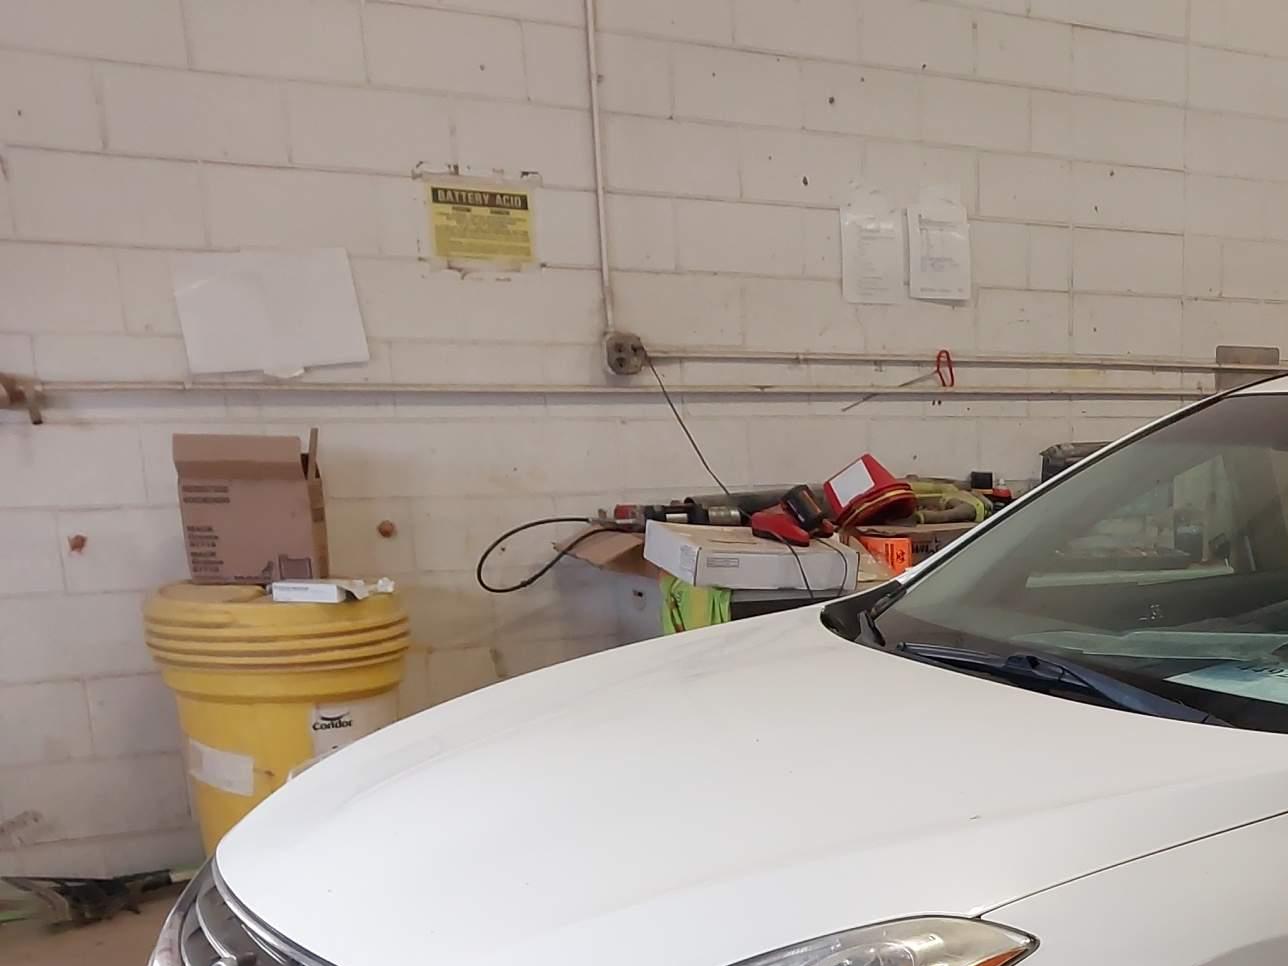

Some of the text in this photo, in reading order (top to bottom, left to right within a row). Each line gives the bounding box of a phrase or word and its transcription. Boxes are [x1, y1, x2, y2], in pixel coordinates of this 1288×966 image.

[438, 189, 522, 209] BATTERY ACID
[312, 719, 354, 732] Condor
